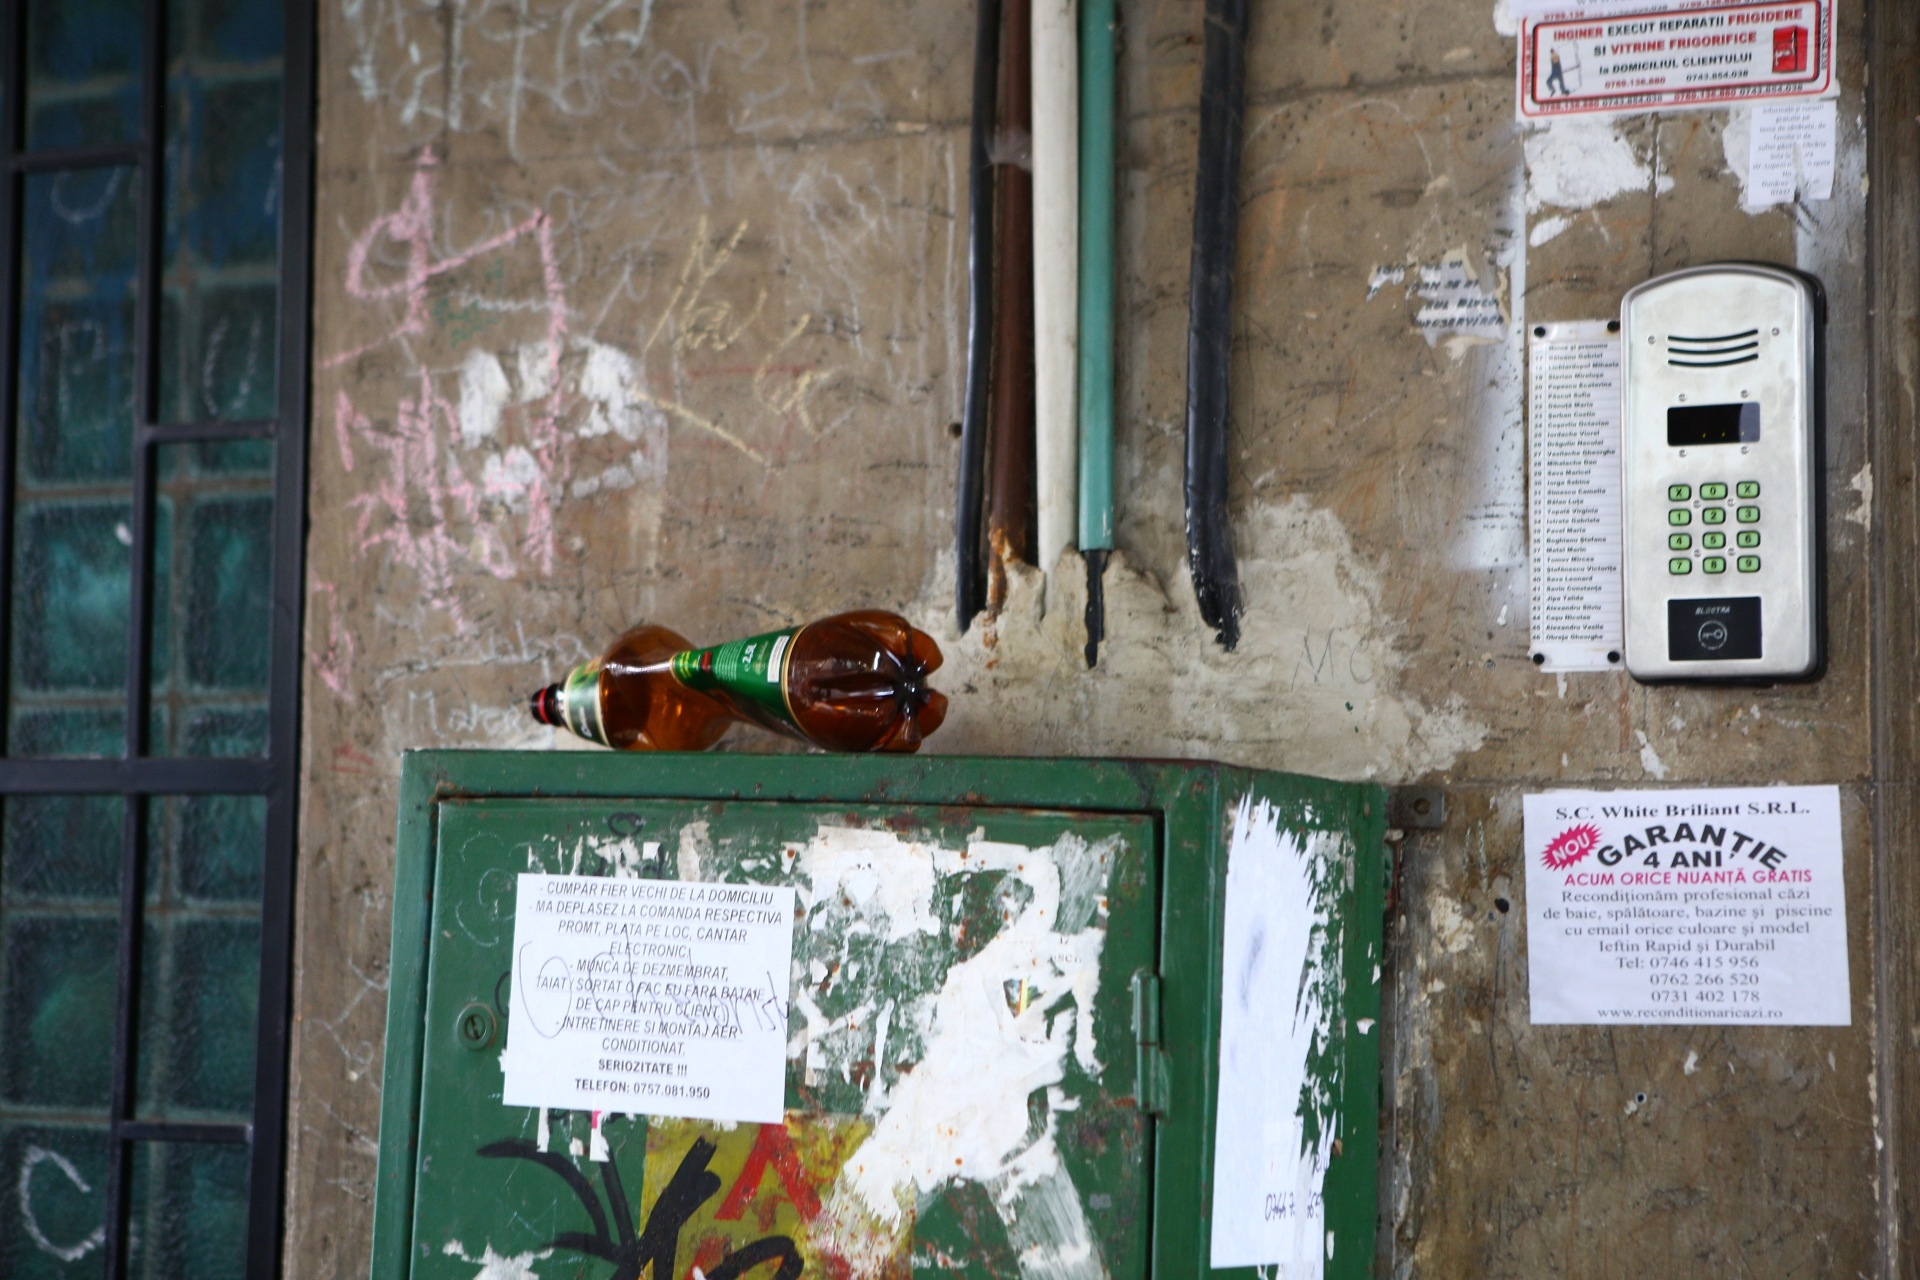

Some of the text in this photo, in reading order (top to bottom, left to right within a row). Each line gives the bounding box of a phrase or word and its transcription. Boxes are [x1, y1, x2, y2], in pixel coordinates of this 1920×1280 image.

[1553, 8, 1803, 41] INGINER EXECUT REPARATII FRIGIDERE
[1593, 32, 1757, 57] SI VITRINE FRIGORIFICE
[1599, 52, 1752, 75] la DOMICILIUL CLIENTULUI
[1556, 801, 1810, 820] S.C. White Briliant S.R.L.
[1552, 832, 1590, 864] NOU
[1643, 851, 1722, 868] 4 ANI
[1564, 873, 1615, 886] ACUM
[1620, 872, 1671, 885] ORICE
[1752, 869, 1812, 884] GRATIS
[600, 882, 627, 898] FIER
[631, 884, 667, 899] VECHI
[669, 886, 687, 900] DE
[689, 887, 705, 901] LA
[708, 888, 774, 905] DOMICILIU
[1684, 888, 1772, 904] profesional
[535, 900, 782, 924] MA DEPLASEZ LA COMANDA RESPECTIVA
[1543, 908, 1560, 919] de
[1566, 908, 1602, 921] baie,
[1695, 905, 1746, 917] bazine
[1775, 904, 1832, 919] piscine
[558, 919, 748, 942] PROMT, PLATA PE LOC, CANTAR
[1564, 926, 1582, 935] cu
[1587, 924, 1630, 935] email
[1635, 924, 1673, 935] orice
[1678, 923, 1736, 935] culoare
[1760, 922, 1810, 934] model
[1599, 940, 1640, 952] Ieftin
[1645, 940, 1691, 954] Rapid
[1715, 939, 1775, 951] Durabil
[577, 959, 729, 982] MUNCA DE DEZMEMBRAT,
[1616, 956, 1759, 969] Tel: 0746 415 956
[536, 975, 568, 990] TAIAT
[576, 978, 623, 993] SORTAT
[636, 981, 662, 995] FAC
[684, 984, 717, 998] FARA
[1650, 973, 1759, 985] 0762 266 520
[1651, 990, 1760, 1002] 0731 402 178
[575, 997, 592, 1010] DE
[596, 998, 620, 1012] CAP
[622, 1000, 672, 1015] PENTRU
[562, 1015, 738, 1039] INTRETINERE SI MONTAJ AER
[598, 1058, 674, 1075] SERIOZITATE
[575, 1078, 711, 1099] TELEFON: 0757.081.950
